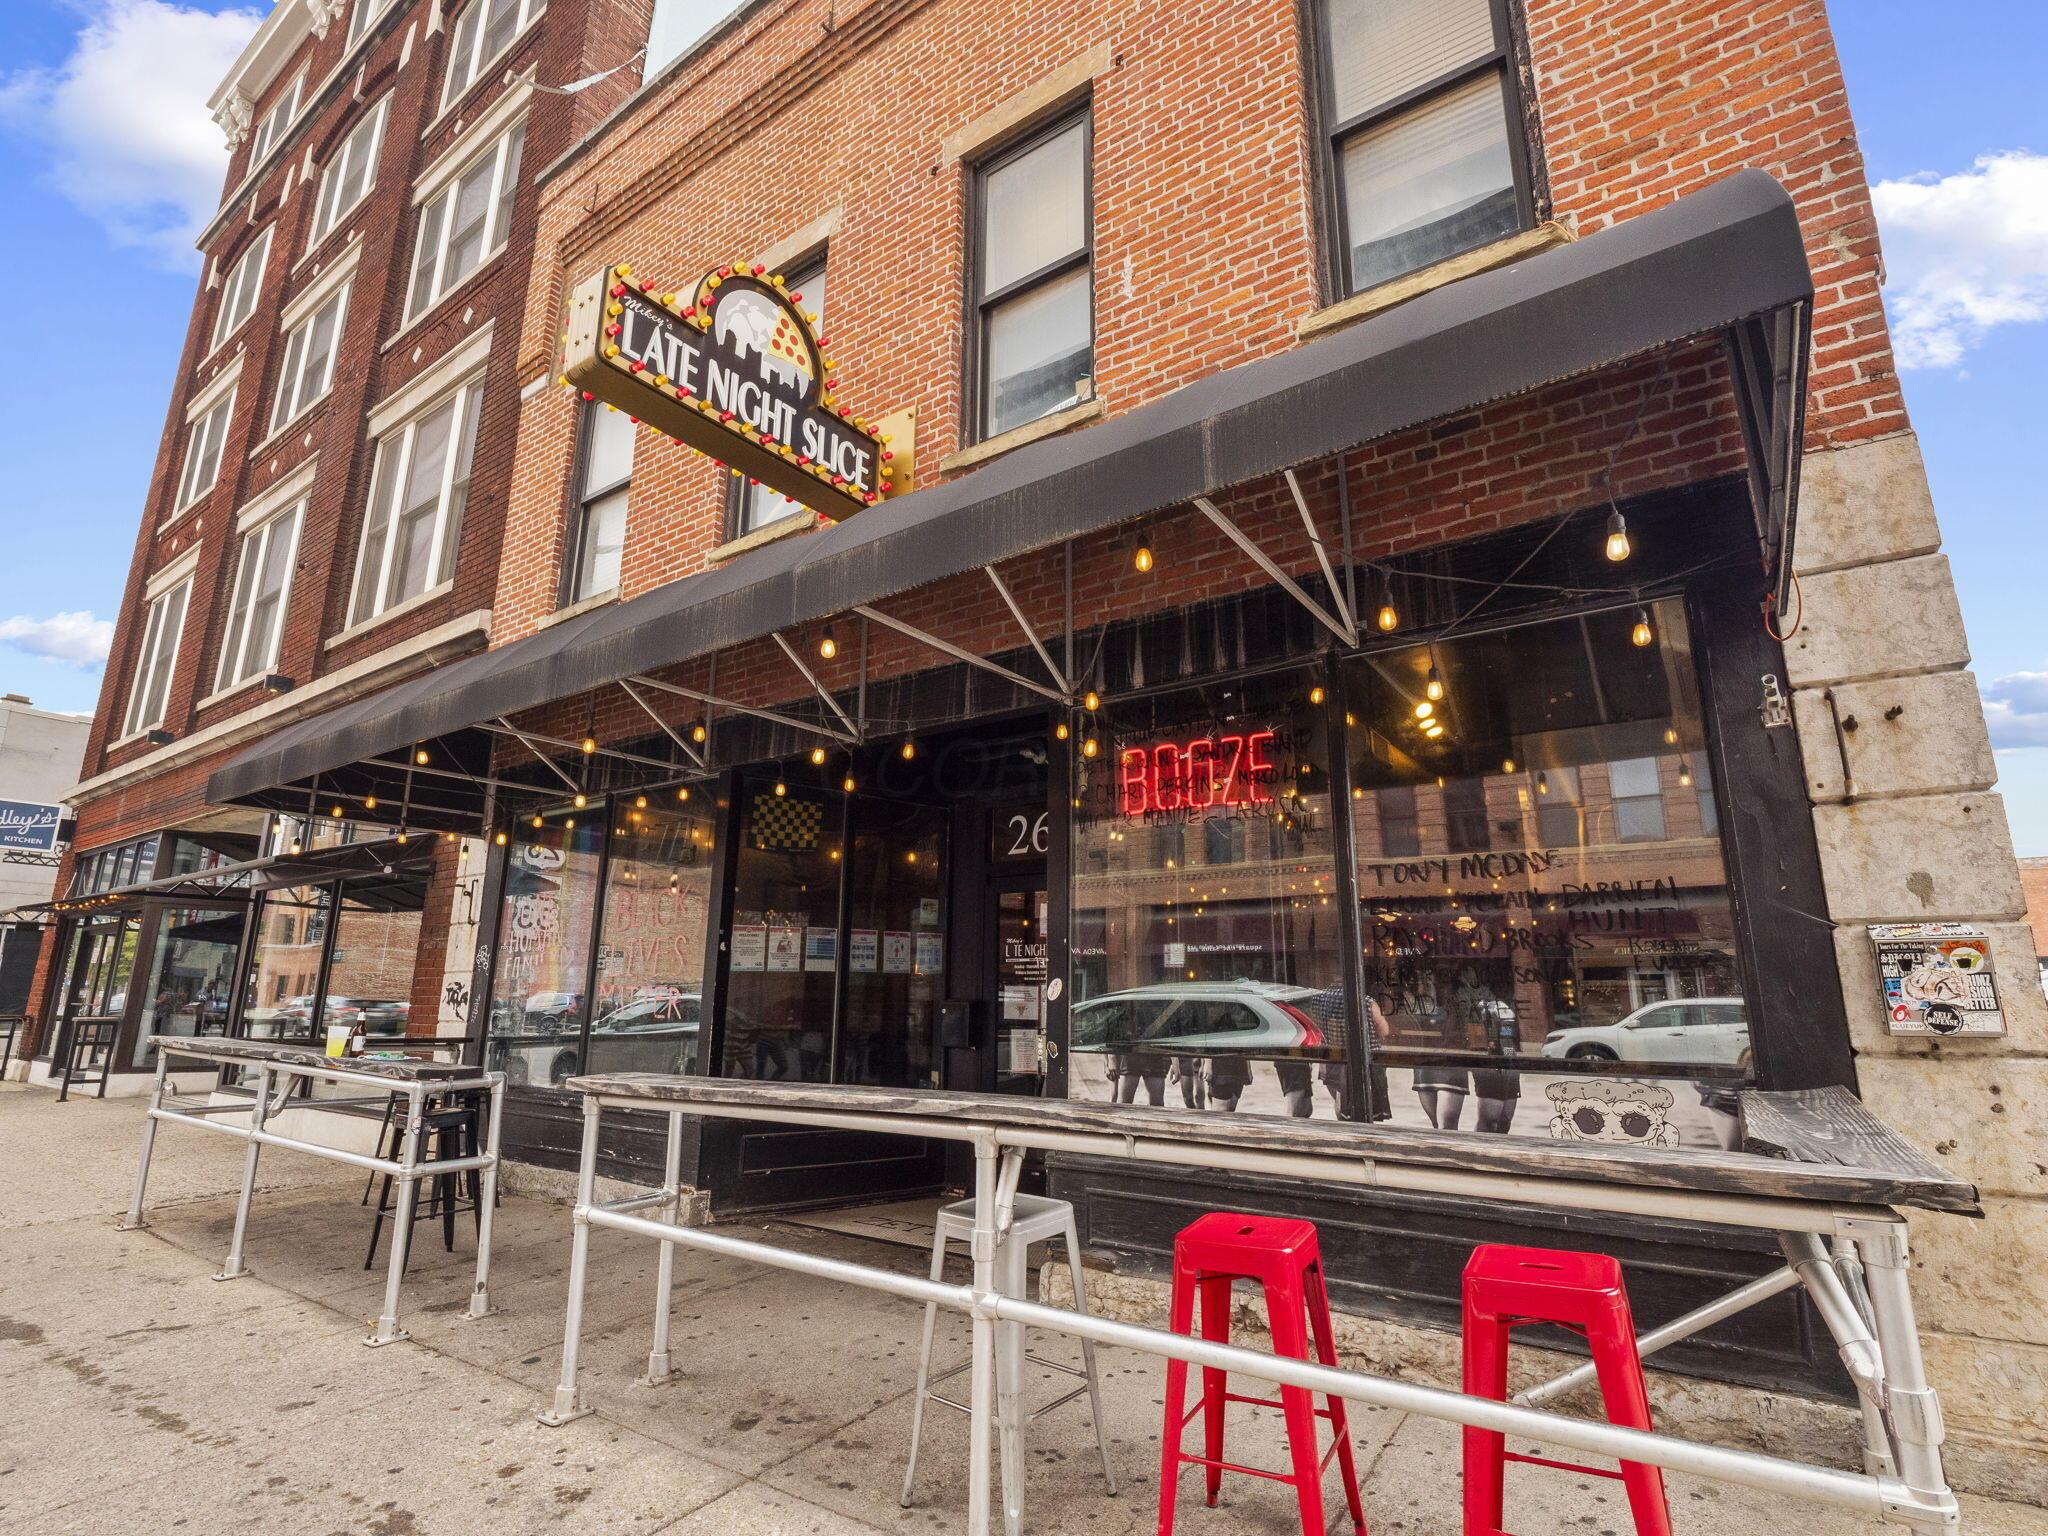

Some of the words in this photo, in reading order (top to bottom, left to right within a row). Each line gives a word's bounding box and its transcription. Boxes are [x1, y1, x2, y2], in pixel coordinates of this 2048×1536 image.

[624, 295, 674, 331] Mikey's
[622, 309, 700, 394] LATE
[706, 358, 797, 446] NIGHT
[801, 417, 870, 492] SLICE
[1123, 731, 1274, 816] BOOZE
[4, 835, 43, 845] KITCHEN
[1368, 858, 1450, 887] TONY
[1568, 906, 1677, 934] HUNT
[1881, 964, 1899, 978] HIGH
[1927, 1017, 1959, 1027] DEFENSE
[1933, 1011, 1953, 1020] SELF
